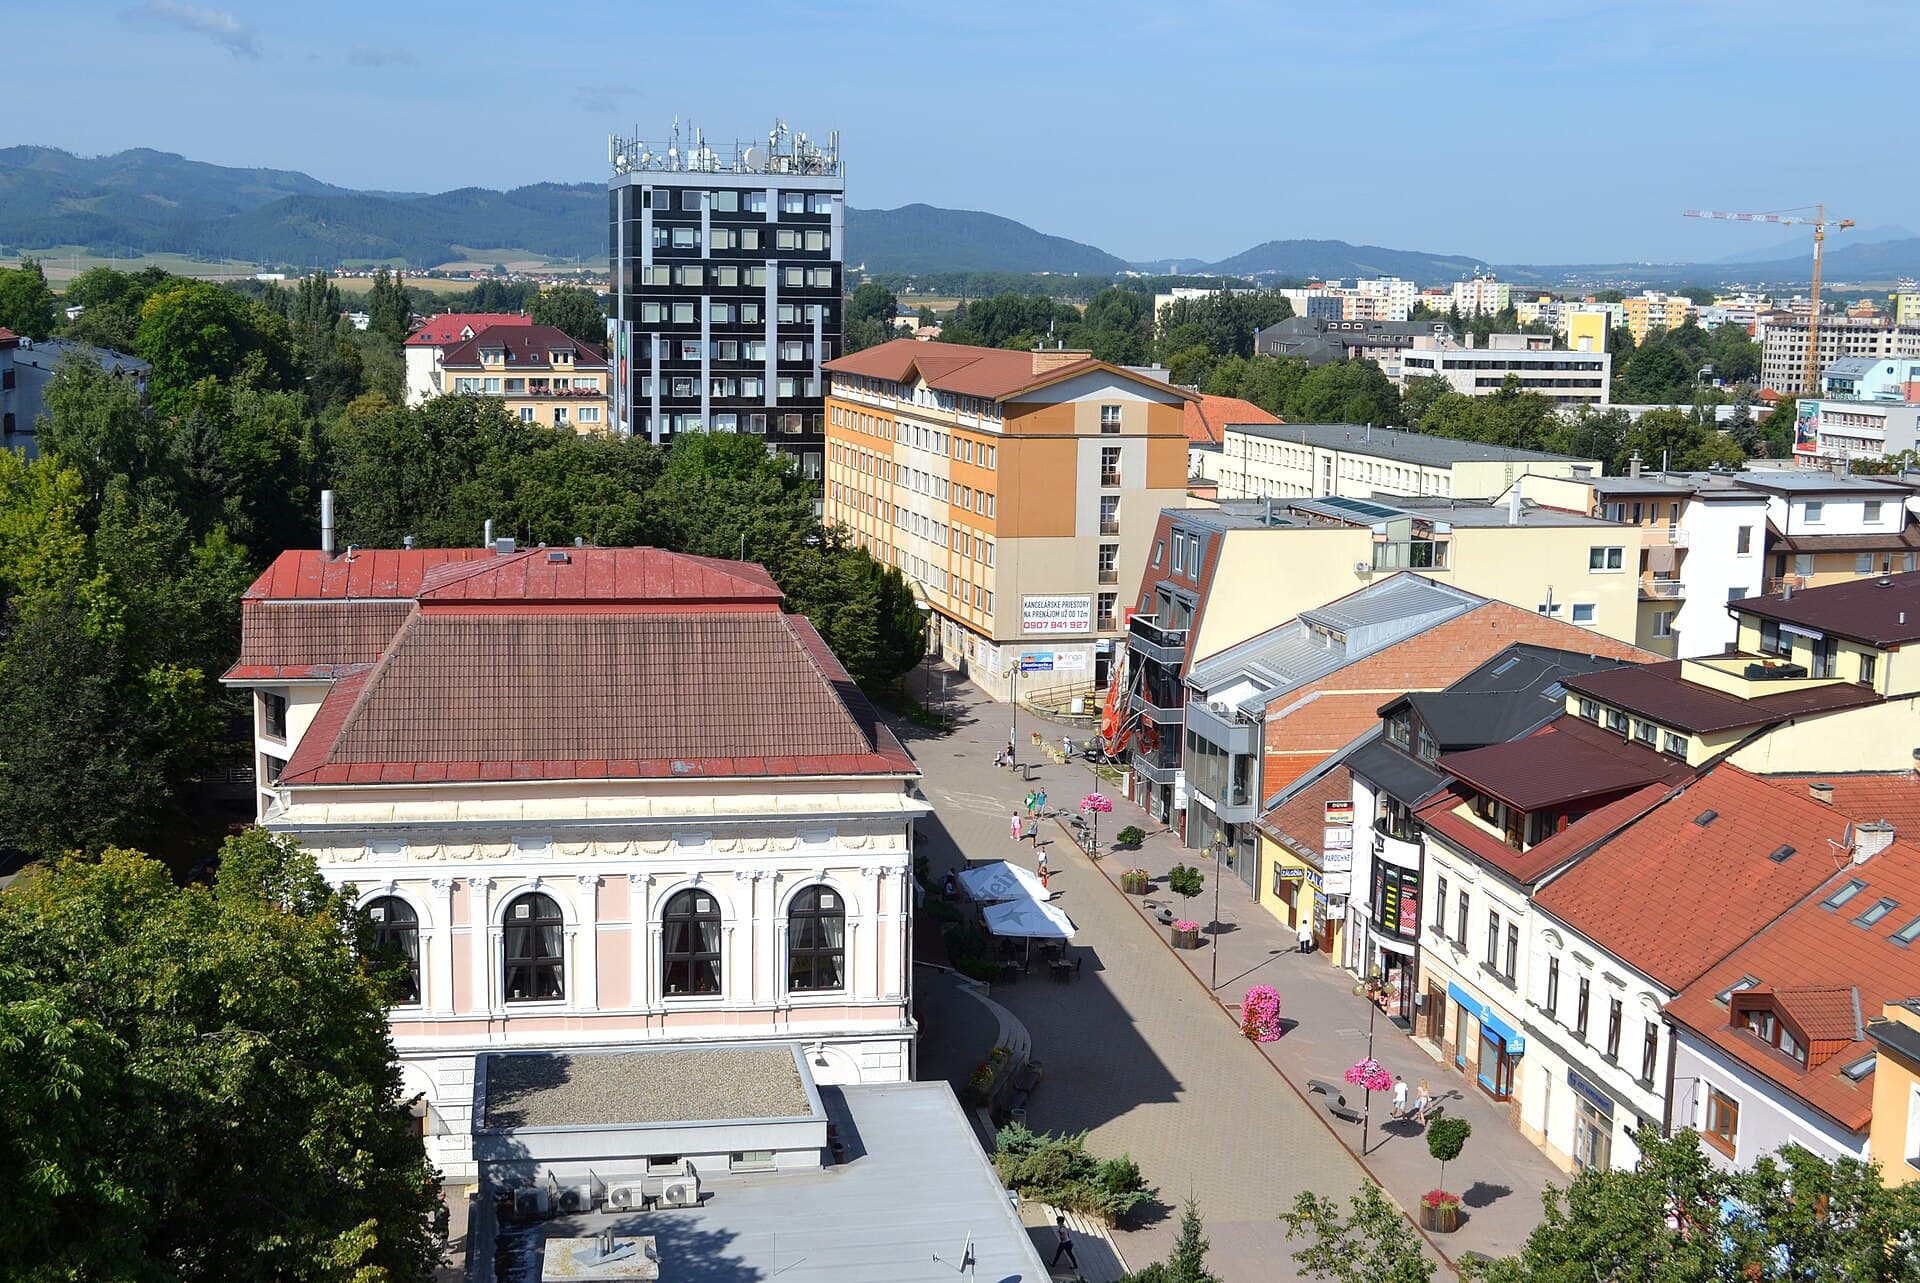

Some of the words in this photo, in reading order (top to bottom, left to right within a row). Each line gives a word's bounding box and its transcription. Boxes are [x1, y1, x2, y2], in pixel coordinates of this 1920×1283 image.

[1024, 600, 1060, 608] KANCELÁRSKE
[1062, 600, 1089, 608] PRIESTORY
[1032, 609, 1059, 617] PRENÁJOM
